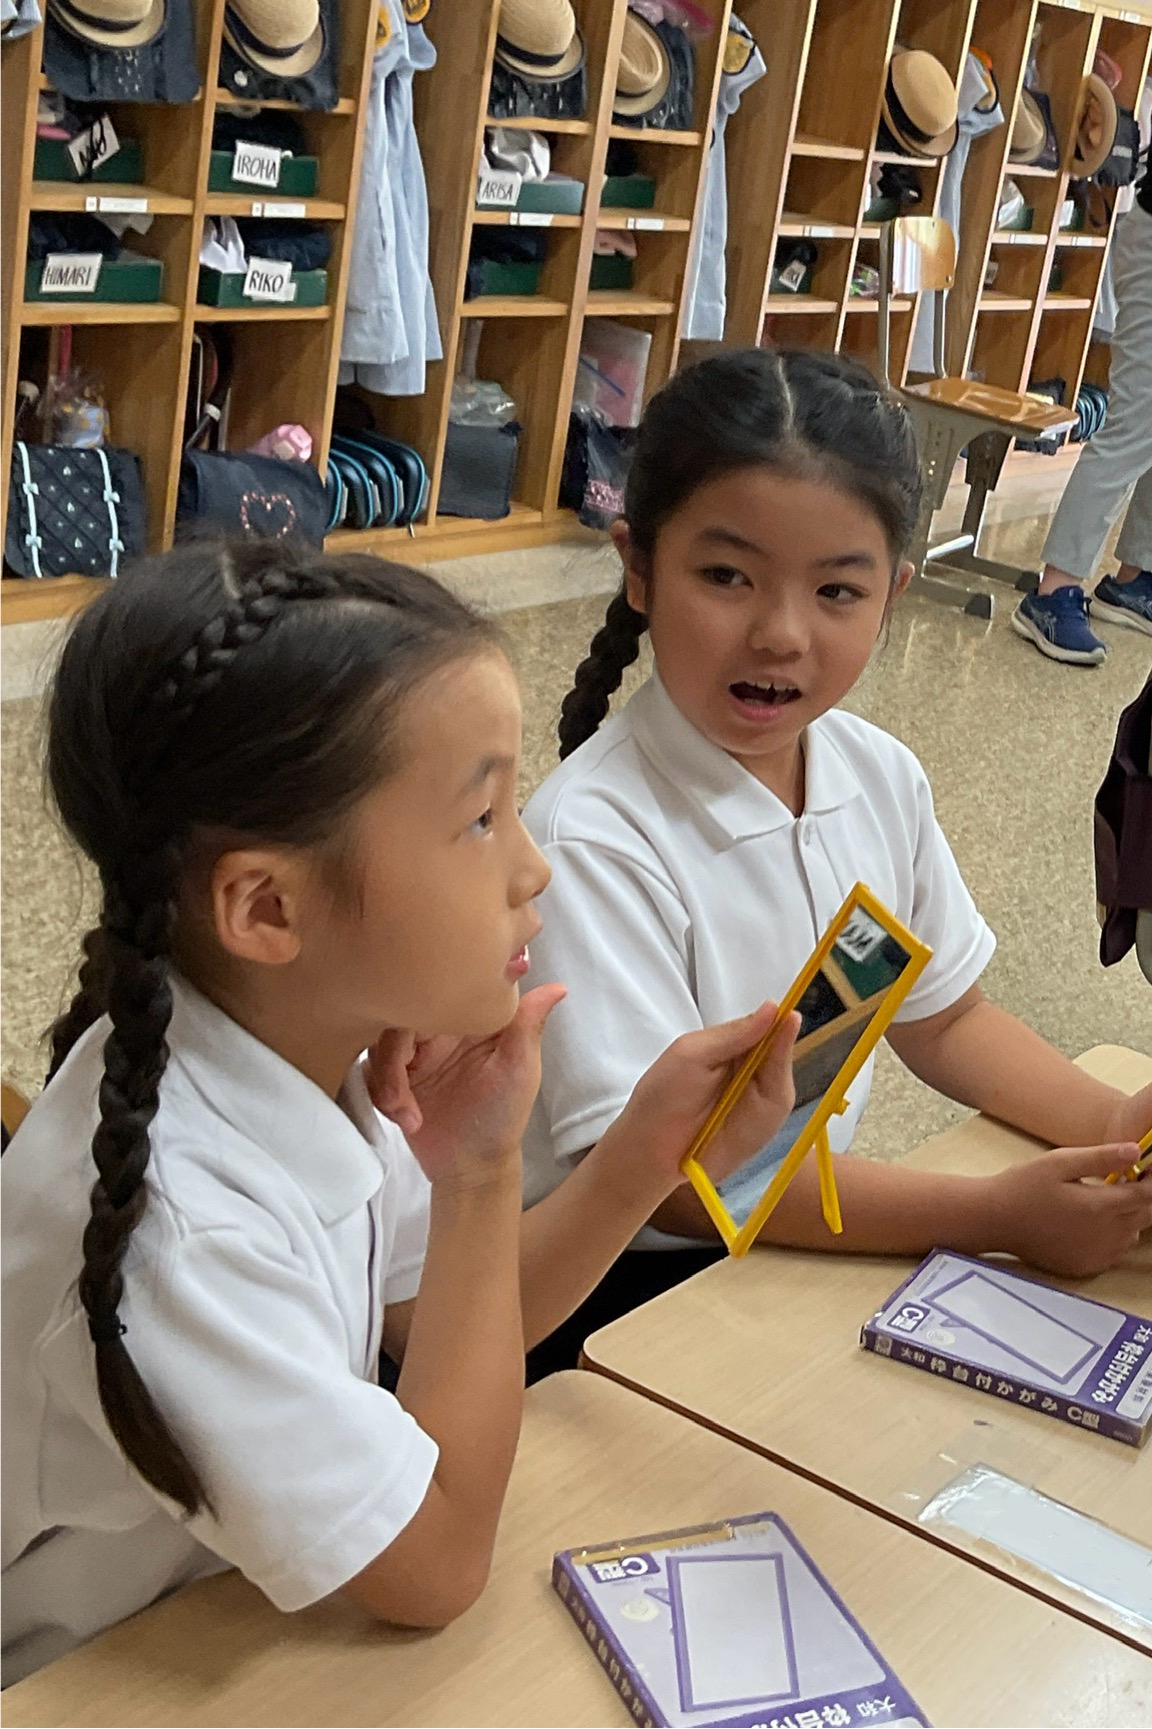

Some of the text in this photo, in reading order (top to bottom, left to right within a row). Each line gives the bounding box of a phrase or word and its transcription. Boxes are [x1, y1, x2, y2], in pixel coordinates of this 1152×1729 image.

[237, 155, 276, 181] IROHA
[482, 181, 513, 200] ARISA
[44, 266, 92, 286] HIMARI
[249, 270, 284, 293] RIKO
[855, 1695, 896, 1718] 大和
